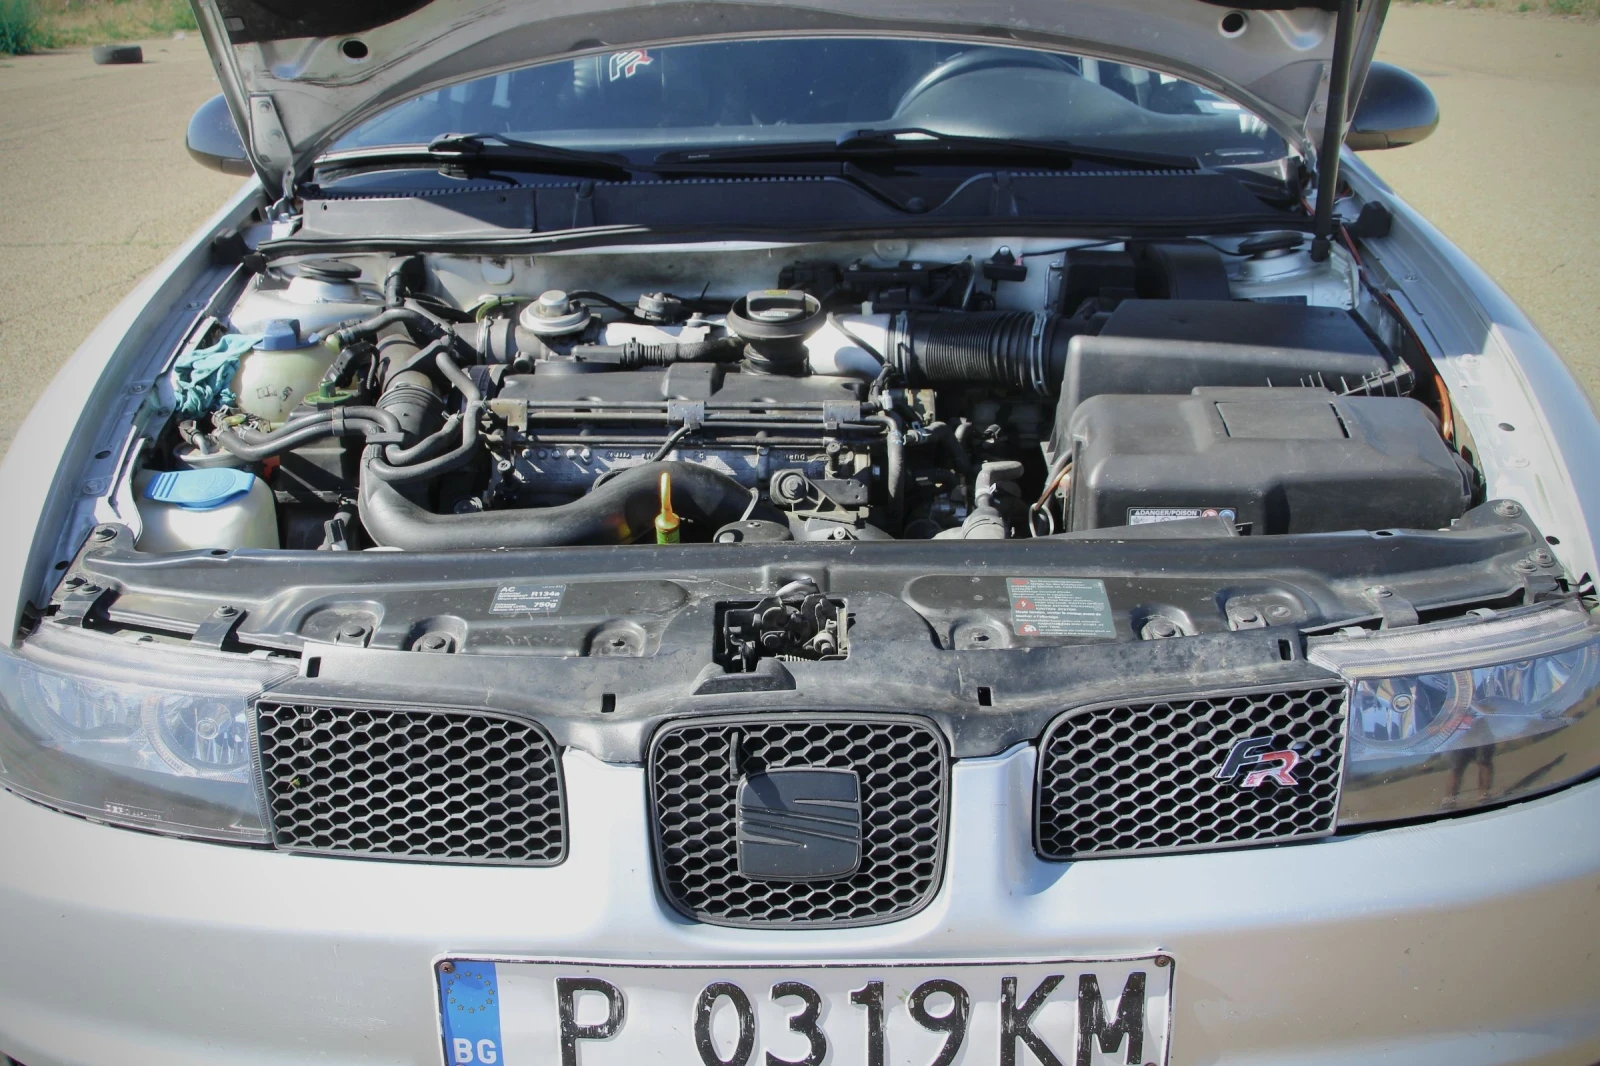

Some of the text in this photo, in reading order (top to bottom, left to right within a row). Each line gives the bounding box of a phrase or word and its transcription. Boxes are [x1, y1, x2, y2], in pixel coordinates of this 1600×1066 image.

[609, 49, 654, 82] FR
[1215, 735, 1299, 788] FR
[554, 972, 1147, 1066] P 0319 KM
[453, 1038, 497, 1064] BG
